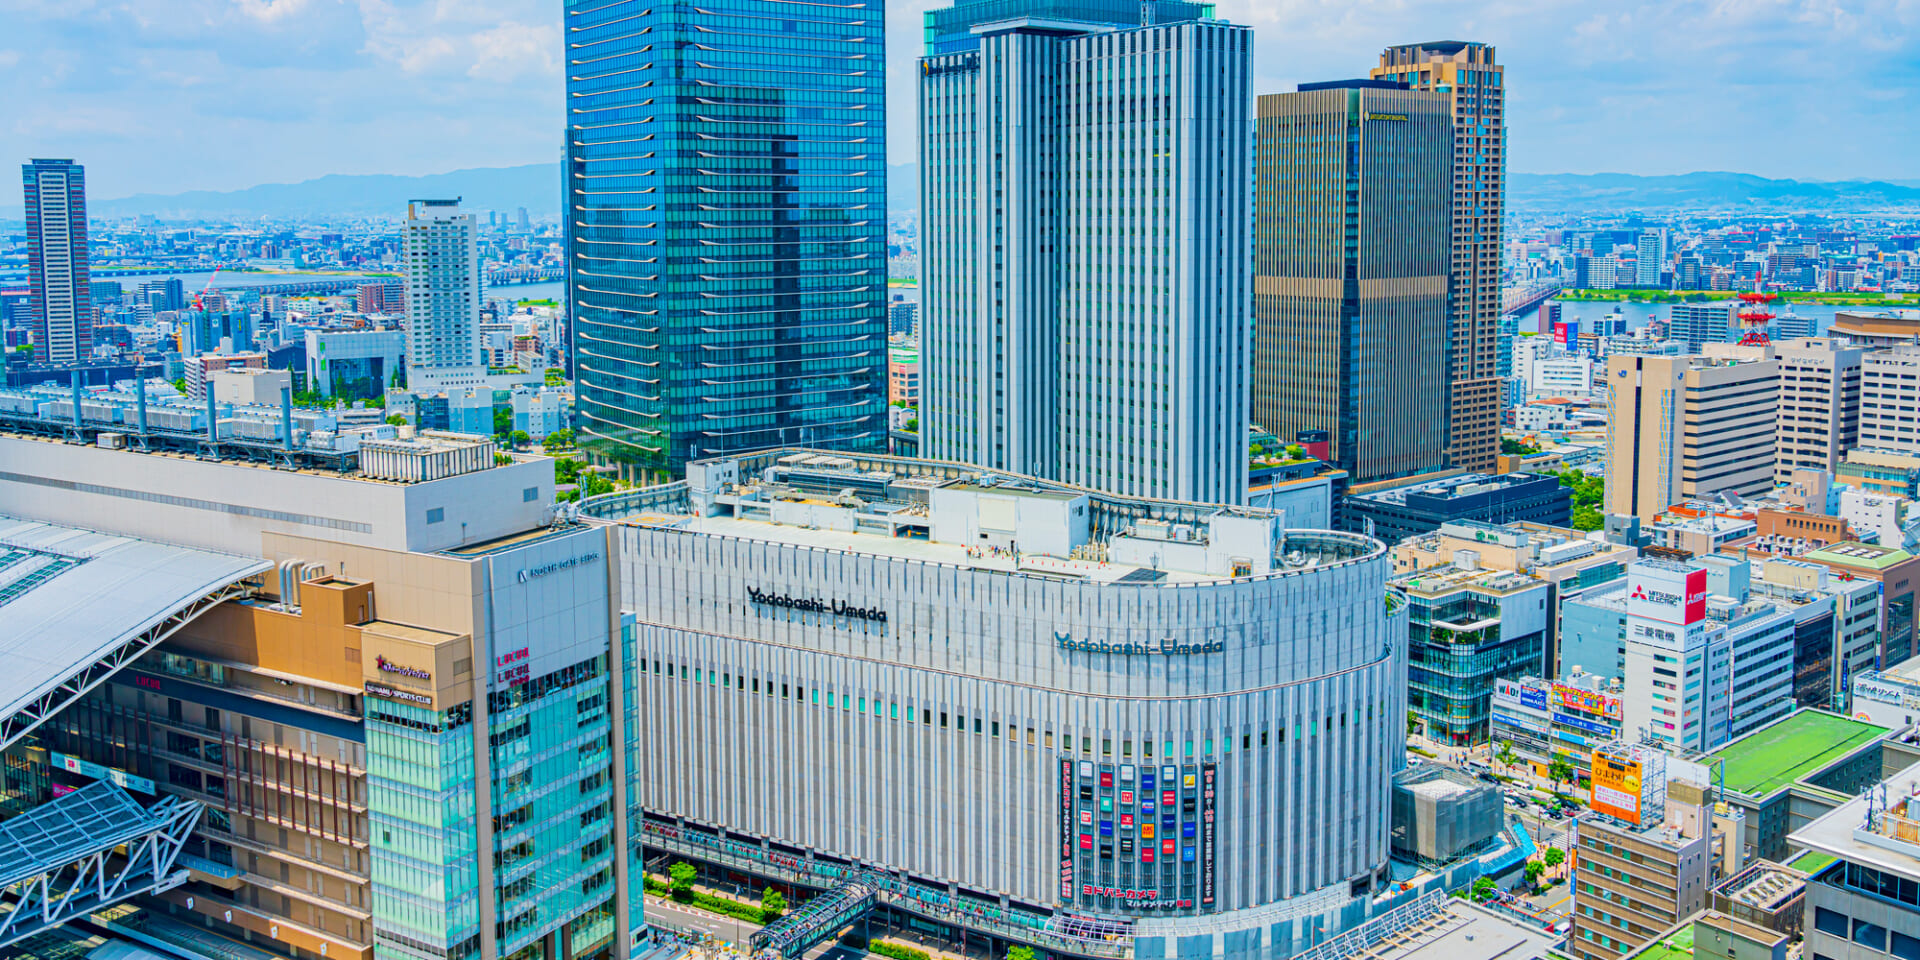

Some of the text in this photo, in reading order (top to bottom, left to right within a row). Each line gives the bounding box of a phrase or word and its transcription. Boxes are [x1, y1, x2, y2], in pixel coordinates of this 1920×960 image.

[747, 585, 887, 622] Yodobashi-Umeda
[1648, 589, 1682, 602] MITSUBISHI
[1648, 596, 1678, 607] ELECTRIC
[1055, 631, 1223, 655] Yodobashi-Umeda
[1083, 884, 1158, 900] ヨドバシカメラ
